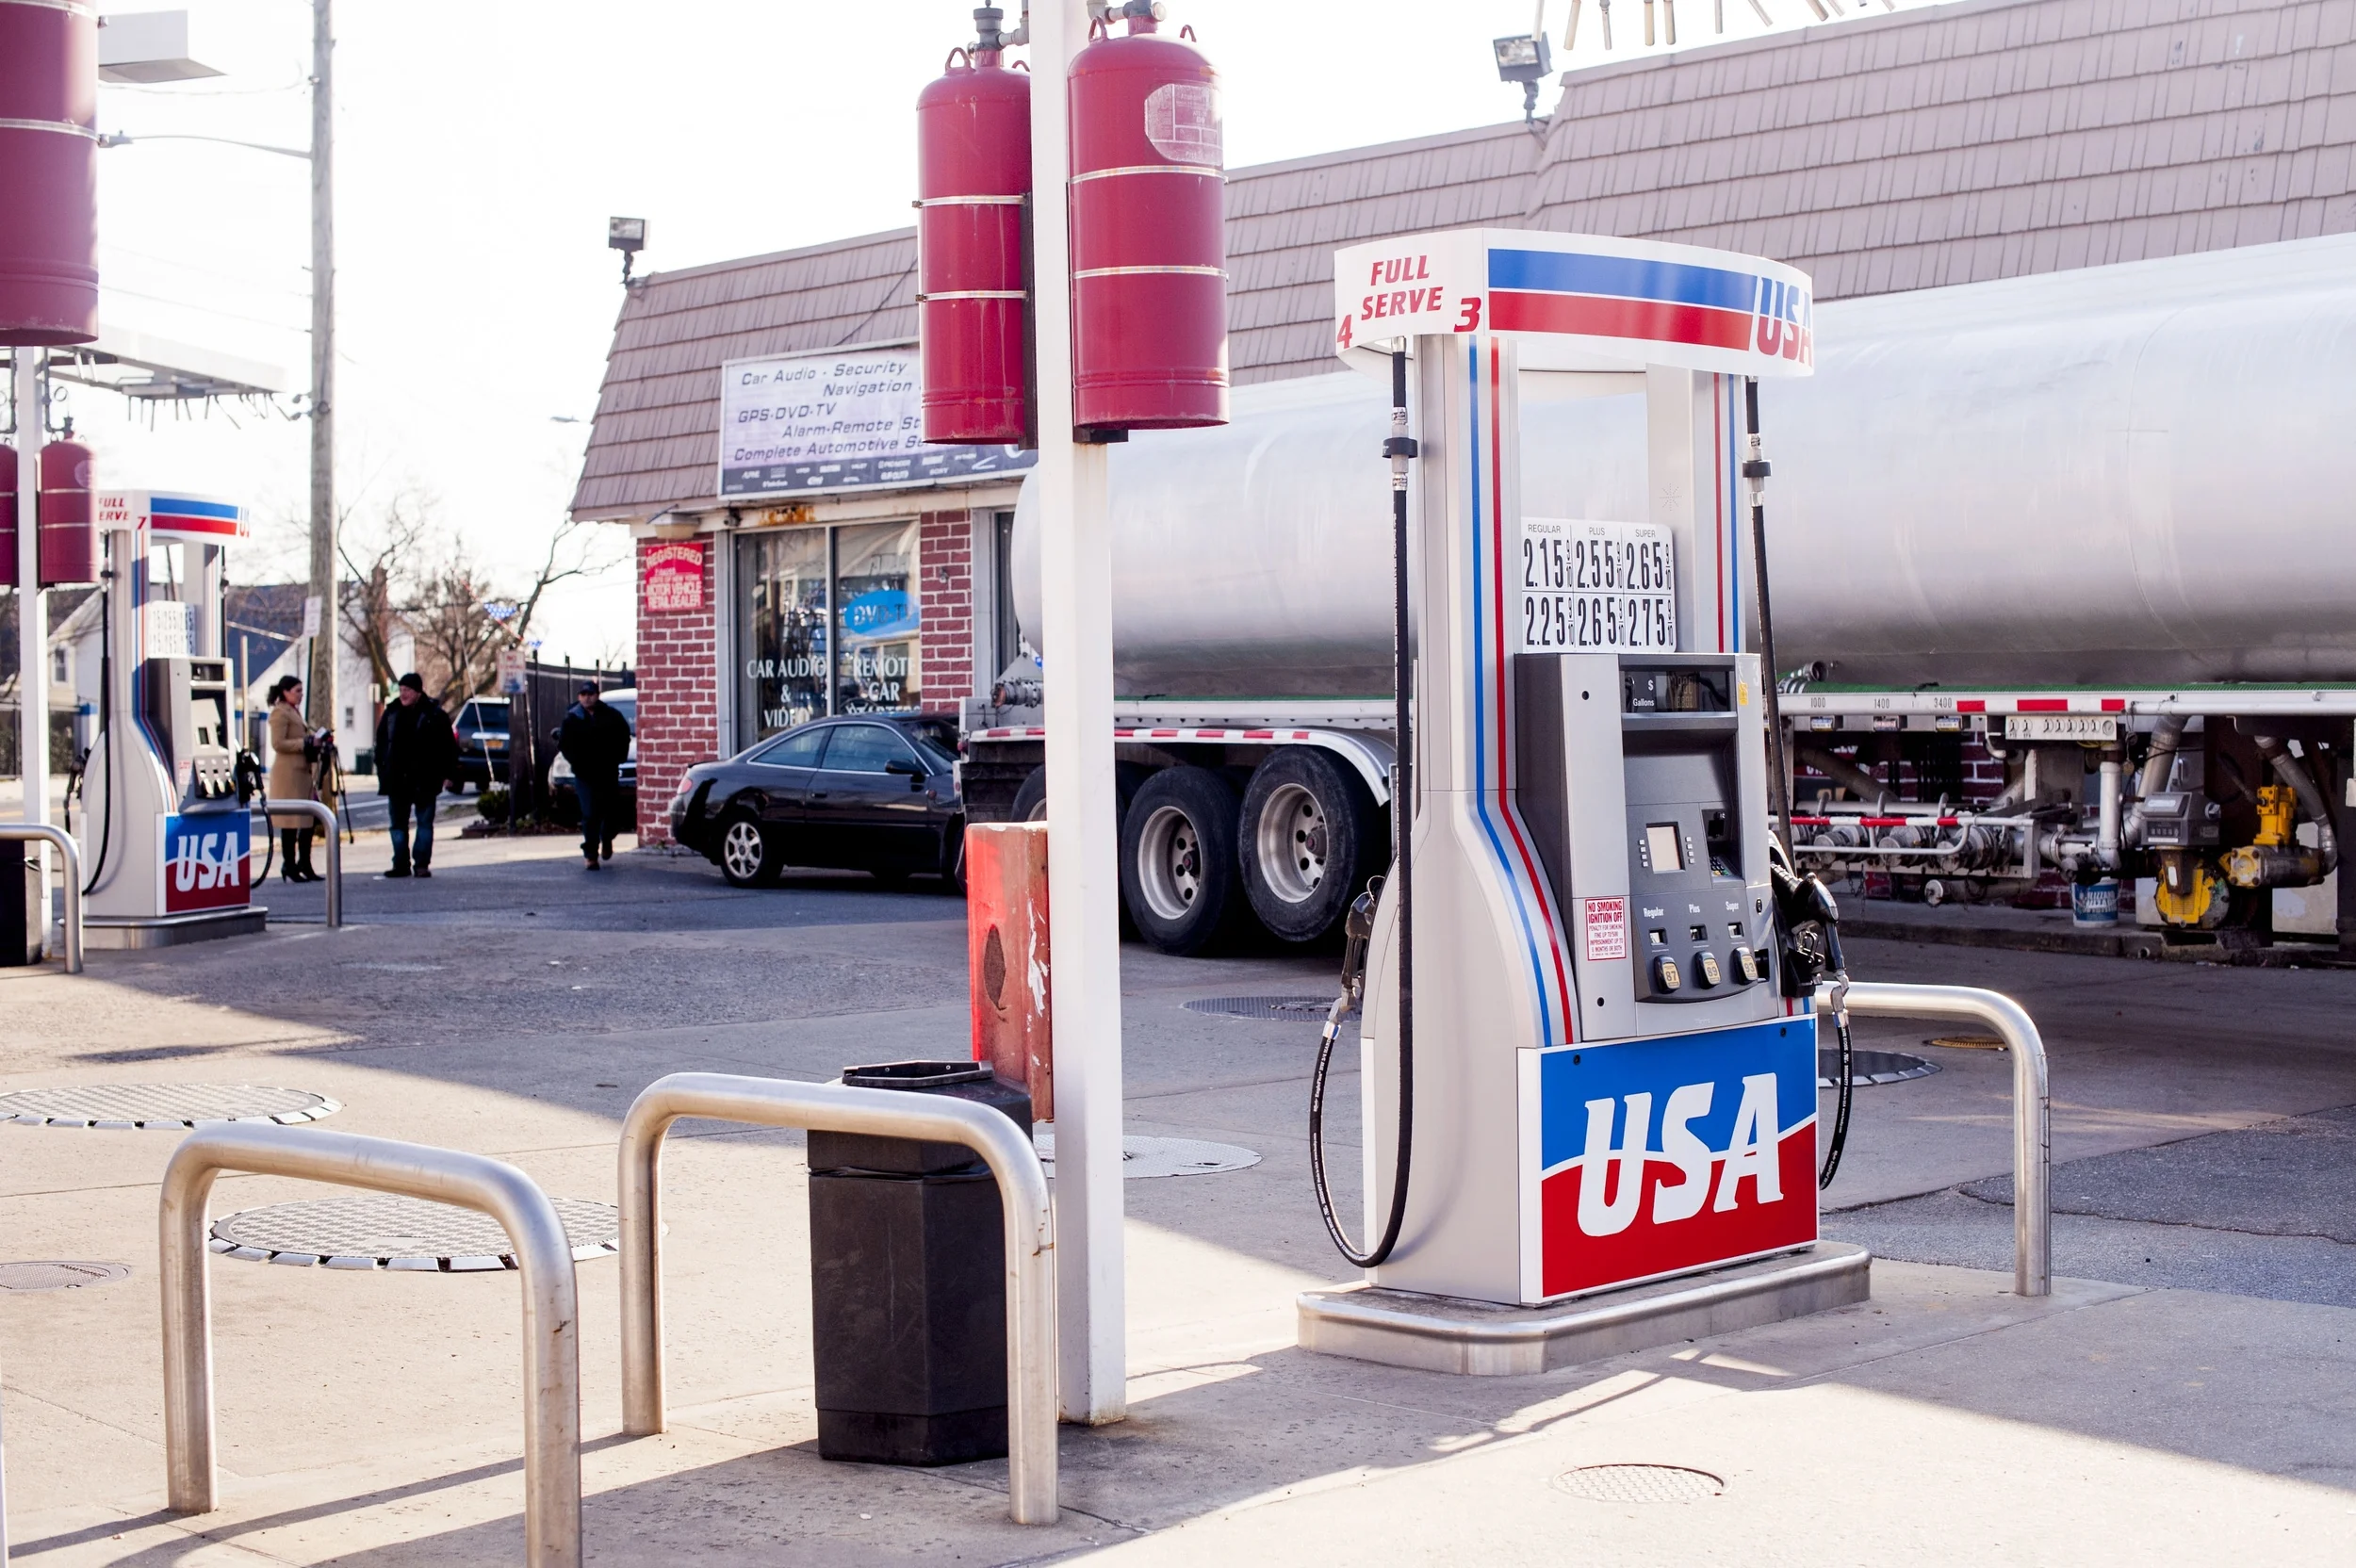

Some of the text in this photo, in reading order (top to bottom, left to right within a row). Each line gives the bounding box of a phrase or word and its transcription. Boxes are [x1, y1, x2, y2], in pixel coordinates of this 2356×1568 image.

[1371, 255, 1430, 286] FULL
[1361, 286, 1443, 320] SERVE
[1454, 297, 1481, 332] 3
[1757, 277, 1813, 368] USA
[1337, 314, 1353, 349] 4
[742, 361, 908, 385] Car Audio Security
[823, 380, 913, 397] Navigation
[734, 445, 801, 462] Complete
[807, 440, 898, 456] Automotive
[99, 511, 130, 521] ERVE
[137, 516, 147, 530] 7
[1528, 524, 1561, 533] REGULAR
[1589, 527, 1605, 536] PLUS
[1635, 529, 1656, 538] SUPER
[646, 546, 703, 569] REGISTERED
[646, 581, 702, 596] MOTOR VEHICLE
[648, 594, 701, 609] RETAIL DEALER
[747, 658, 826, 679] CAR AUDIO
[853, 656, 915, 677] REMOTE
[1753, 662, 1759, 686] 3
[868, 682, 900, 701] CAR
[1648, 680, 1653, 691] $
[781, 684, 791, 703] &
[1633, 698, 1654, 707] Gallons
[1811, 697, 1826, 708] 1000
[1874, 699, 1890, 709] 1400
[1934, 698, 1952, 708] 3400
[764, 708, 810, 728] VIDEO
[175, 831, 240, 892] USA
[1588, 901, 1622, 912] NO SMOKING
[1643, 907, 1664, 919] Regular
[1688, 903, 1700, 913] Plus
[1725, 901, 1739, 912] Super
[1588, 912, 1622, 924] IGNITION OFF
[1706, 967, 1718, 977] 89
[1744, 963, 1755, 973] 93
[1666, 971, 1676, 982] 87
[1577, 1072, 1784, 1237] USA
